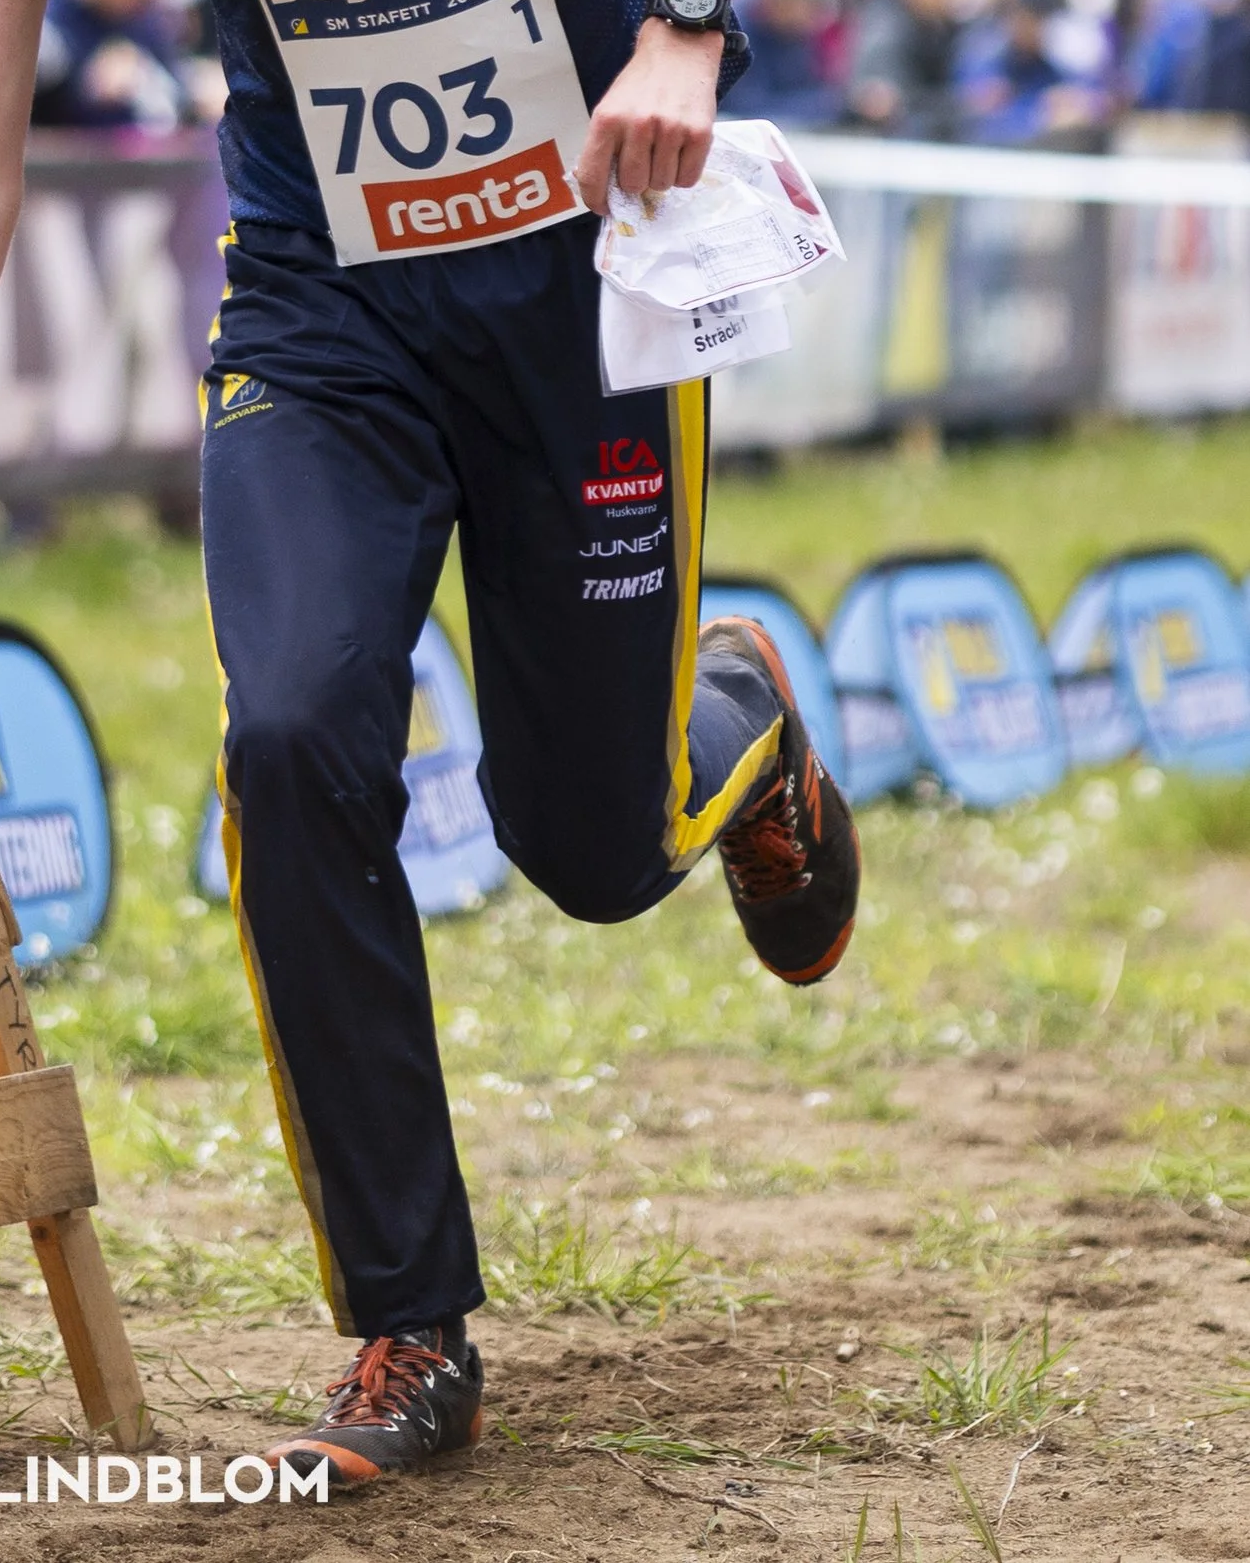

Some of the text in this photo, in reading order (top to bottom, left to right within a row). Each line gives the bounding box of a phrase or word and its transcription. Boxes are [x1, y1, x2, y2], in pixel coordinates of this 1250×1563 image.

[327, 17, 350, 31] SM
[357, 2, 432, 29] STAFETT
[309, 56, 514, 175] 703
[387, 169, 551, 237] renta
[793, 234, 815, 260] H20
[214, 402, 274, 430] HUSKVARNA
[599, 438, 659, 475] ICA
[579, 530, 662, 557] JUNET
[582, 566, 666, 601] TRIMTEX
